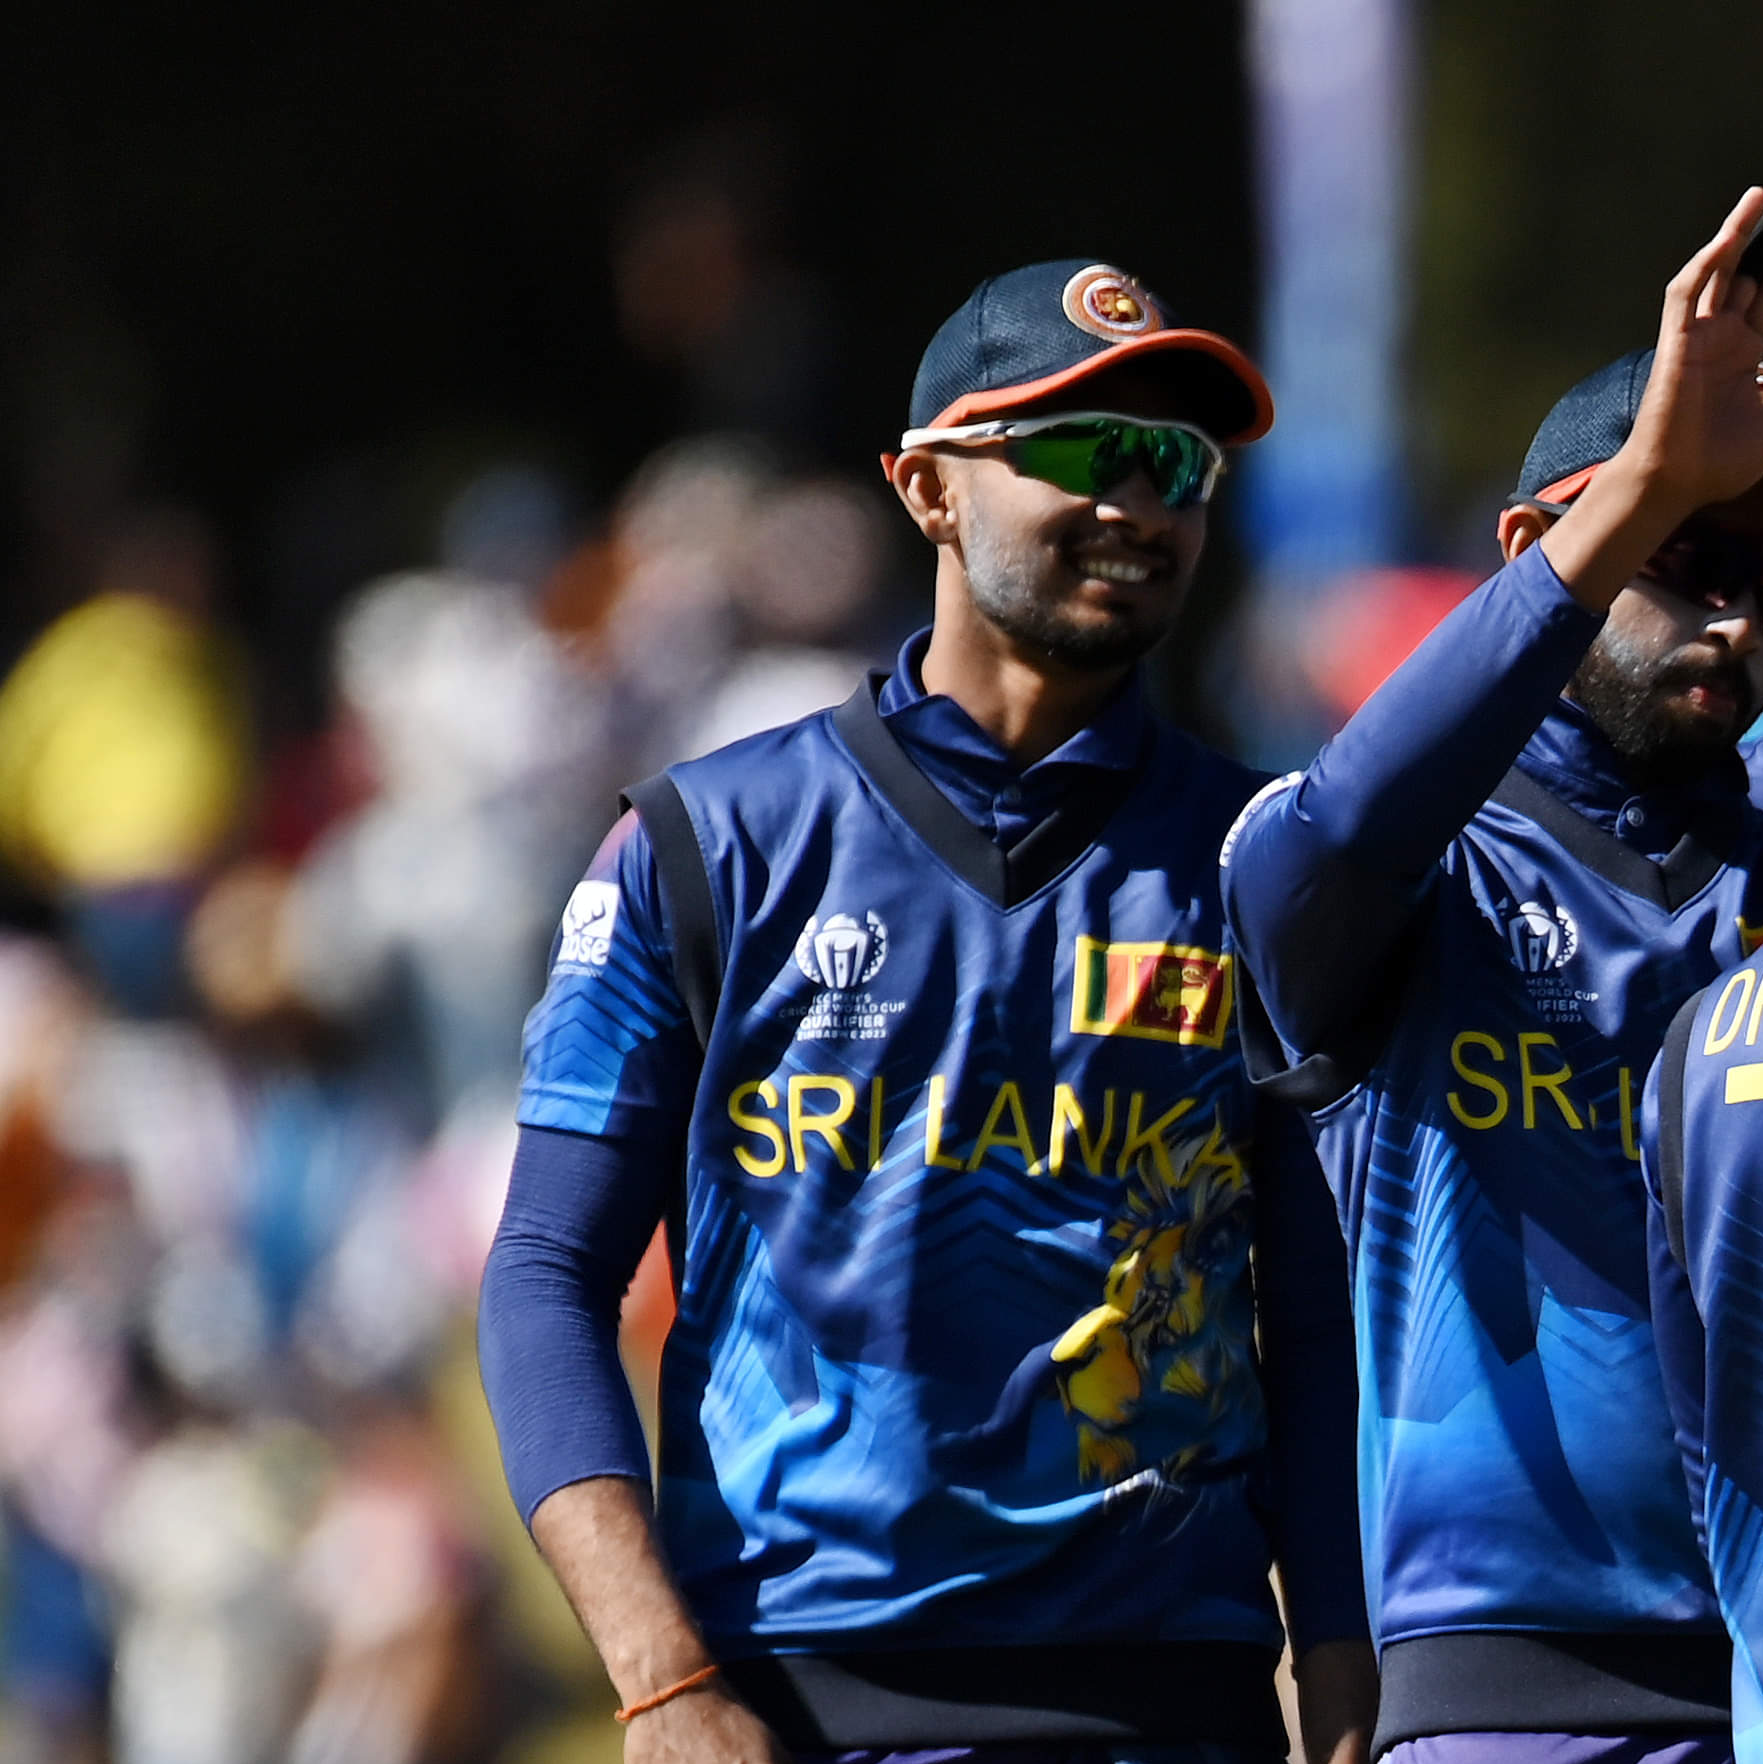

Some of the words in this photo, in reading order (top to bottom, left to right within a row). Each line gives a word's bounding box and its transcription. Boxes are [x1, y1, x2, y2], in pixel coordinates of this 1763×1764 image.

[1574, 990, 1599, 1001] CUP
[880, 1002, 907, 1013] CUP
[800, 1014, 885, 1029] QUALIFIER
[728, 1074, 883, 1178] SRI
